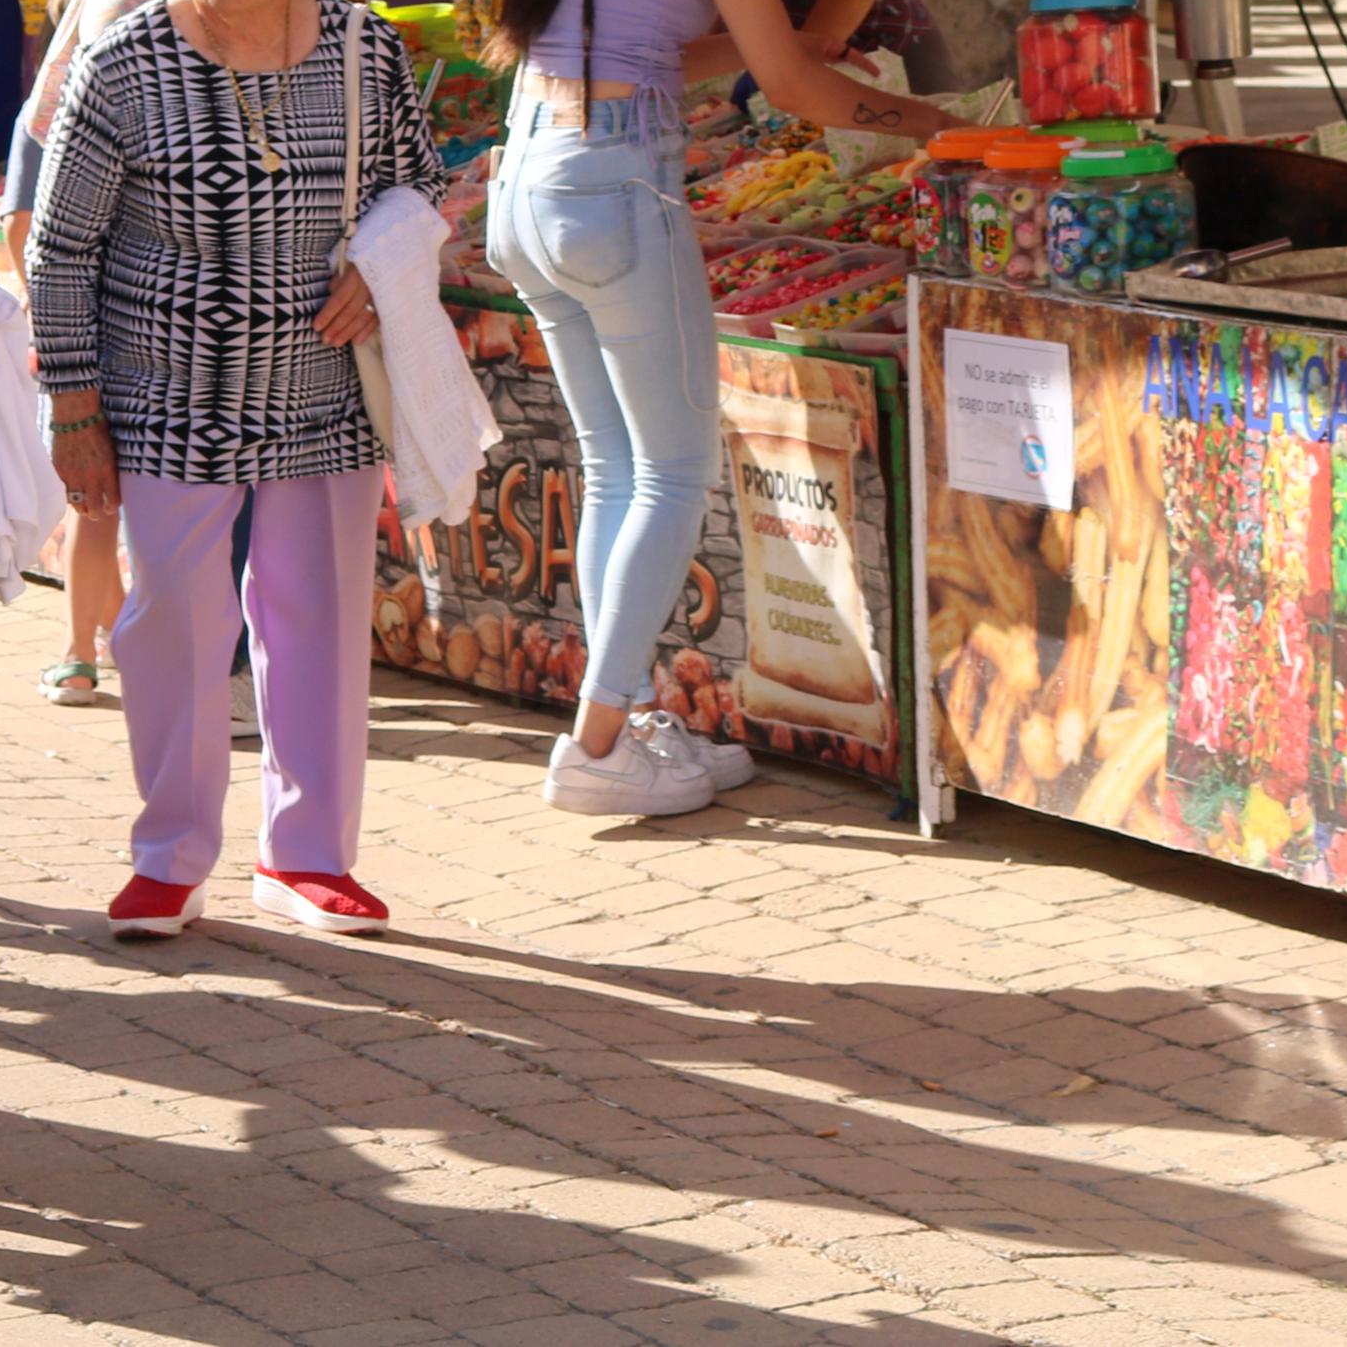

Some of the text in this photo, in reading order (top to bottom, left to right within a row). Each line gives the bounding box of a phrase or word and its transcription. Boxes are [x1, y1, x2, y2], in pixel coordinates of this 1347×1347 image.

[964, 363, 1051, 390] NO se admite el
[1143, 334, 1235, 428] ANA
[957, 395, 984, 415] pago
[986, 400, 1005, 414] con
[741, 463, 838, 513] PRODUCTOS
